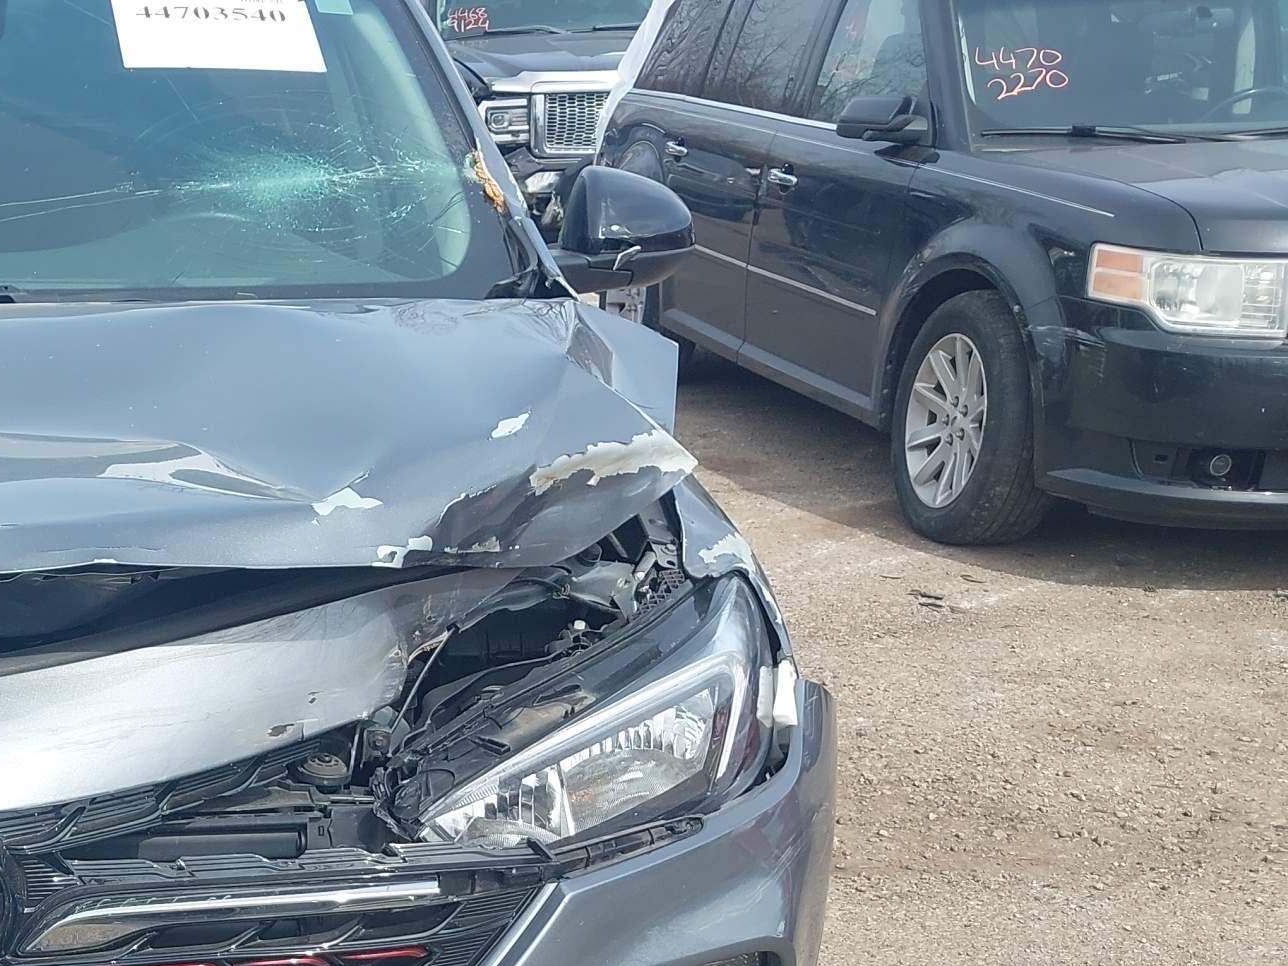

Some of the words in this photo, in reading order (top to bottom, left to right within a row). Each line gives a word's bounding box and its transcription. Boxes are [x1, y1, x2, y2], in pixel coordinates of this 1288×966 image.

[135, 5, 287, 23] 44703540
[447, 7, 488, 20] 4468
[445, 18, 489, 33] 9124
[975, 46, 1062, 71] 4470
[987, 67, 1069, 100] 2270
